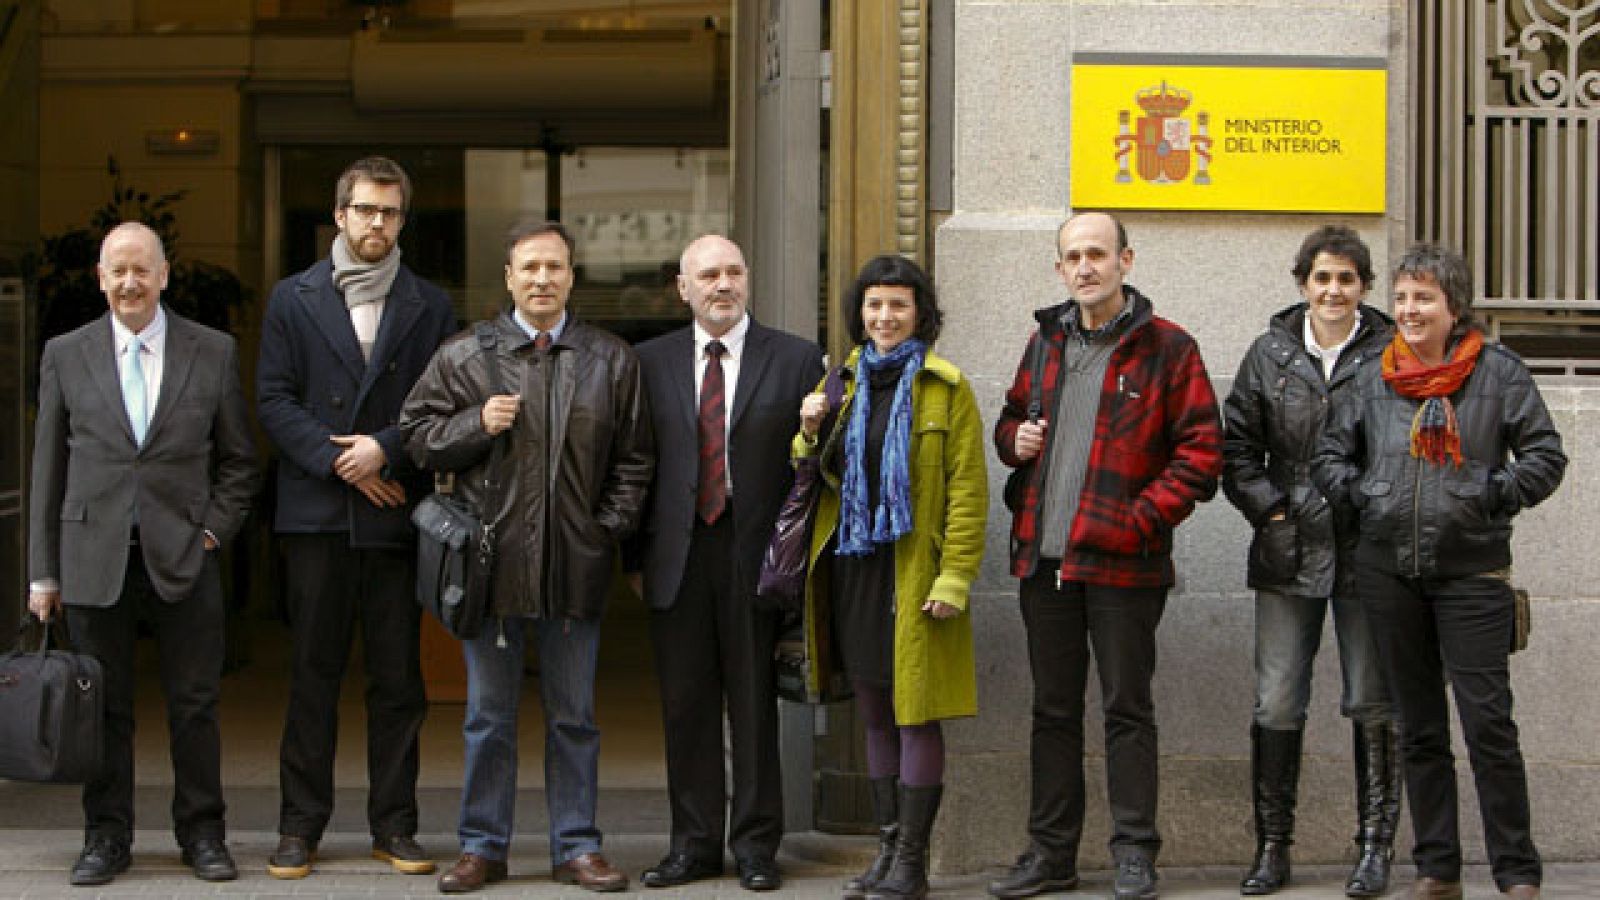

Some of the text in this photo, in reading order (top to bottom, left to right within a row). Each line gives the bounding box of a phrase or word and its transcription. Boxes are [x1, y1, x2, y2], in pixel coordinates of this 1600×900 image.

[1224, 119, 1322, 135] MINISTERIO
[1224, 137, 1341, 154] DEL INTERIOR
